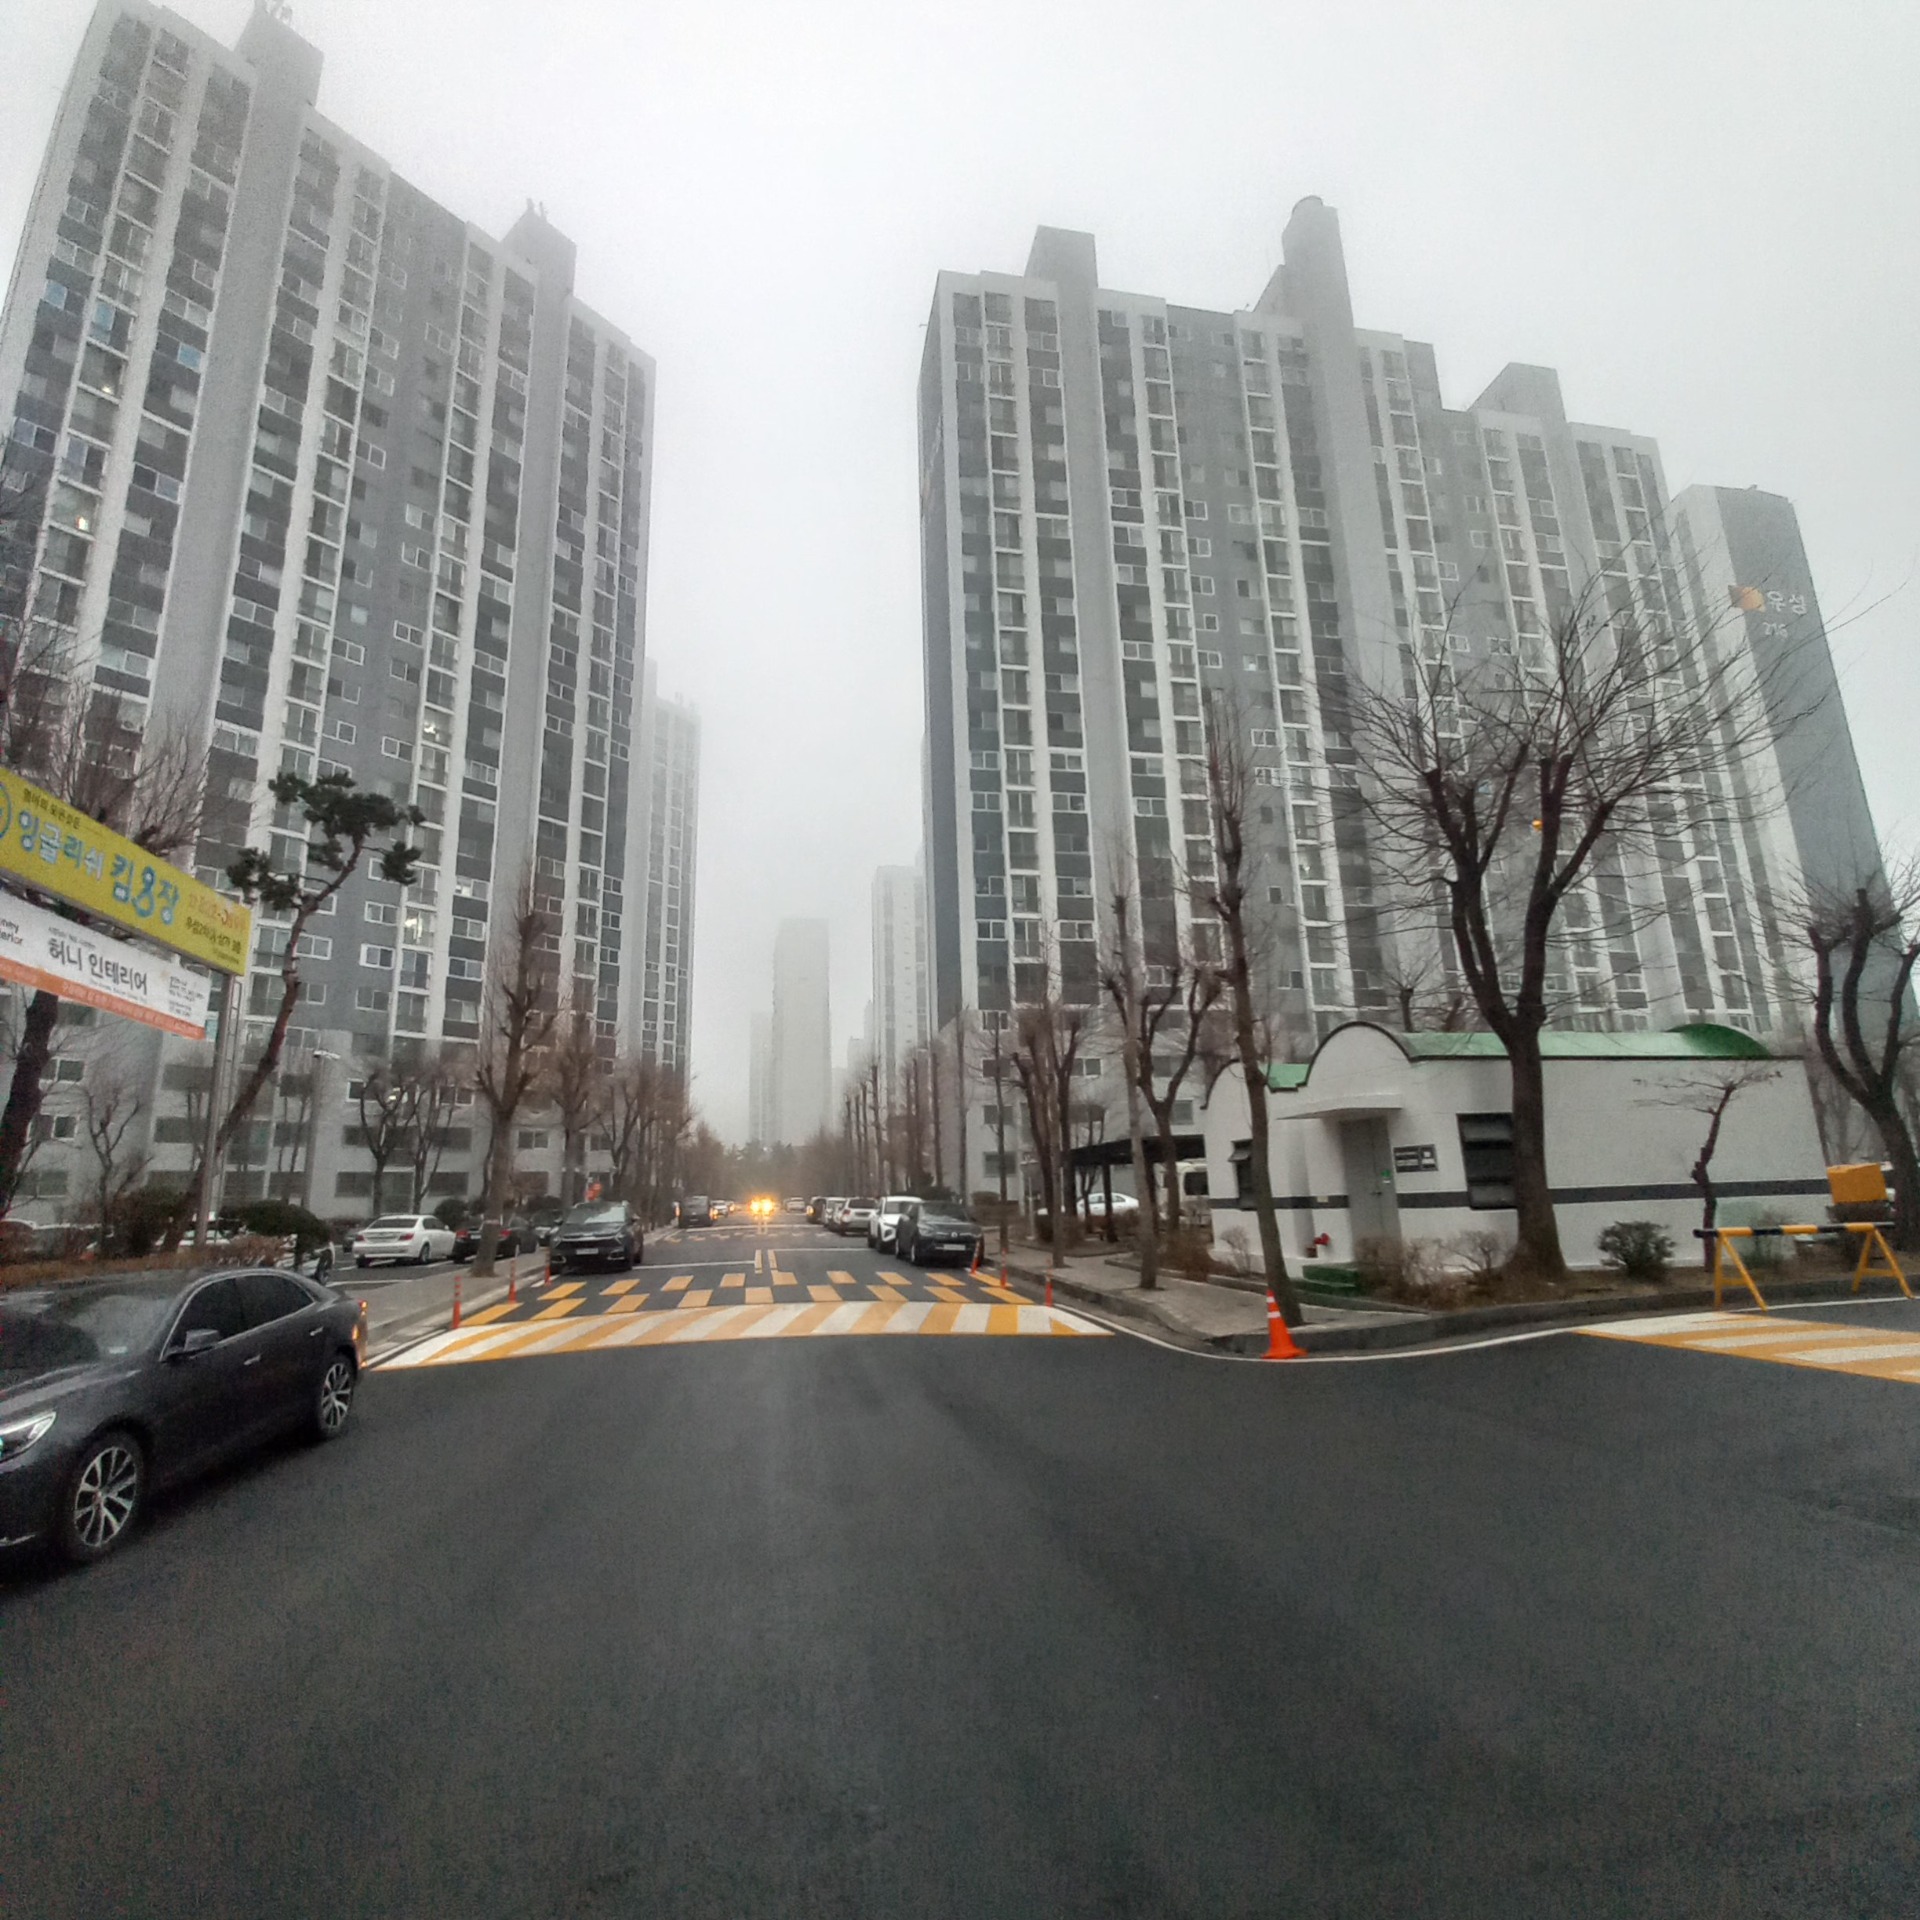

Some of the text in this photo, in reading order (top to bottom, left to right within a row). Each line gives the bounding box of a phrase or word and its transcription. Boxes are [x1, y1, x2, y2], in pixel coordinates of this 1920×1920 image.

[1766, 590, 1808, 616] 우성
[18, 810, 105, 882] 잉글리쉬
[48, 937, 83, 972] 허니
[88, 953, 148, 996] 인테리어
